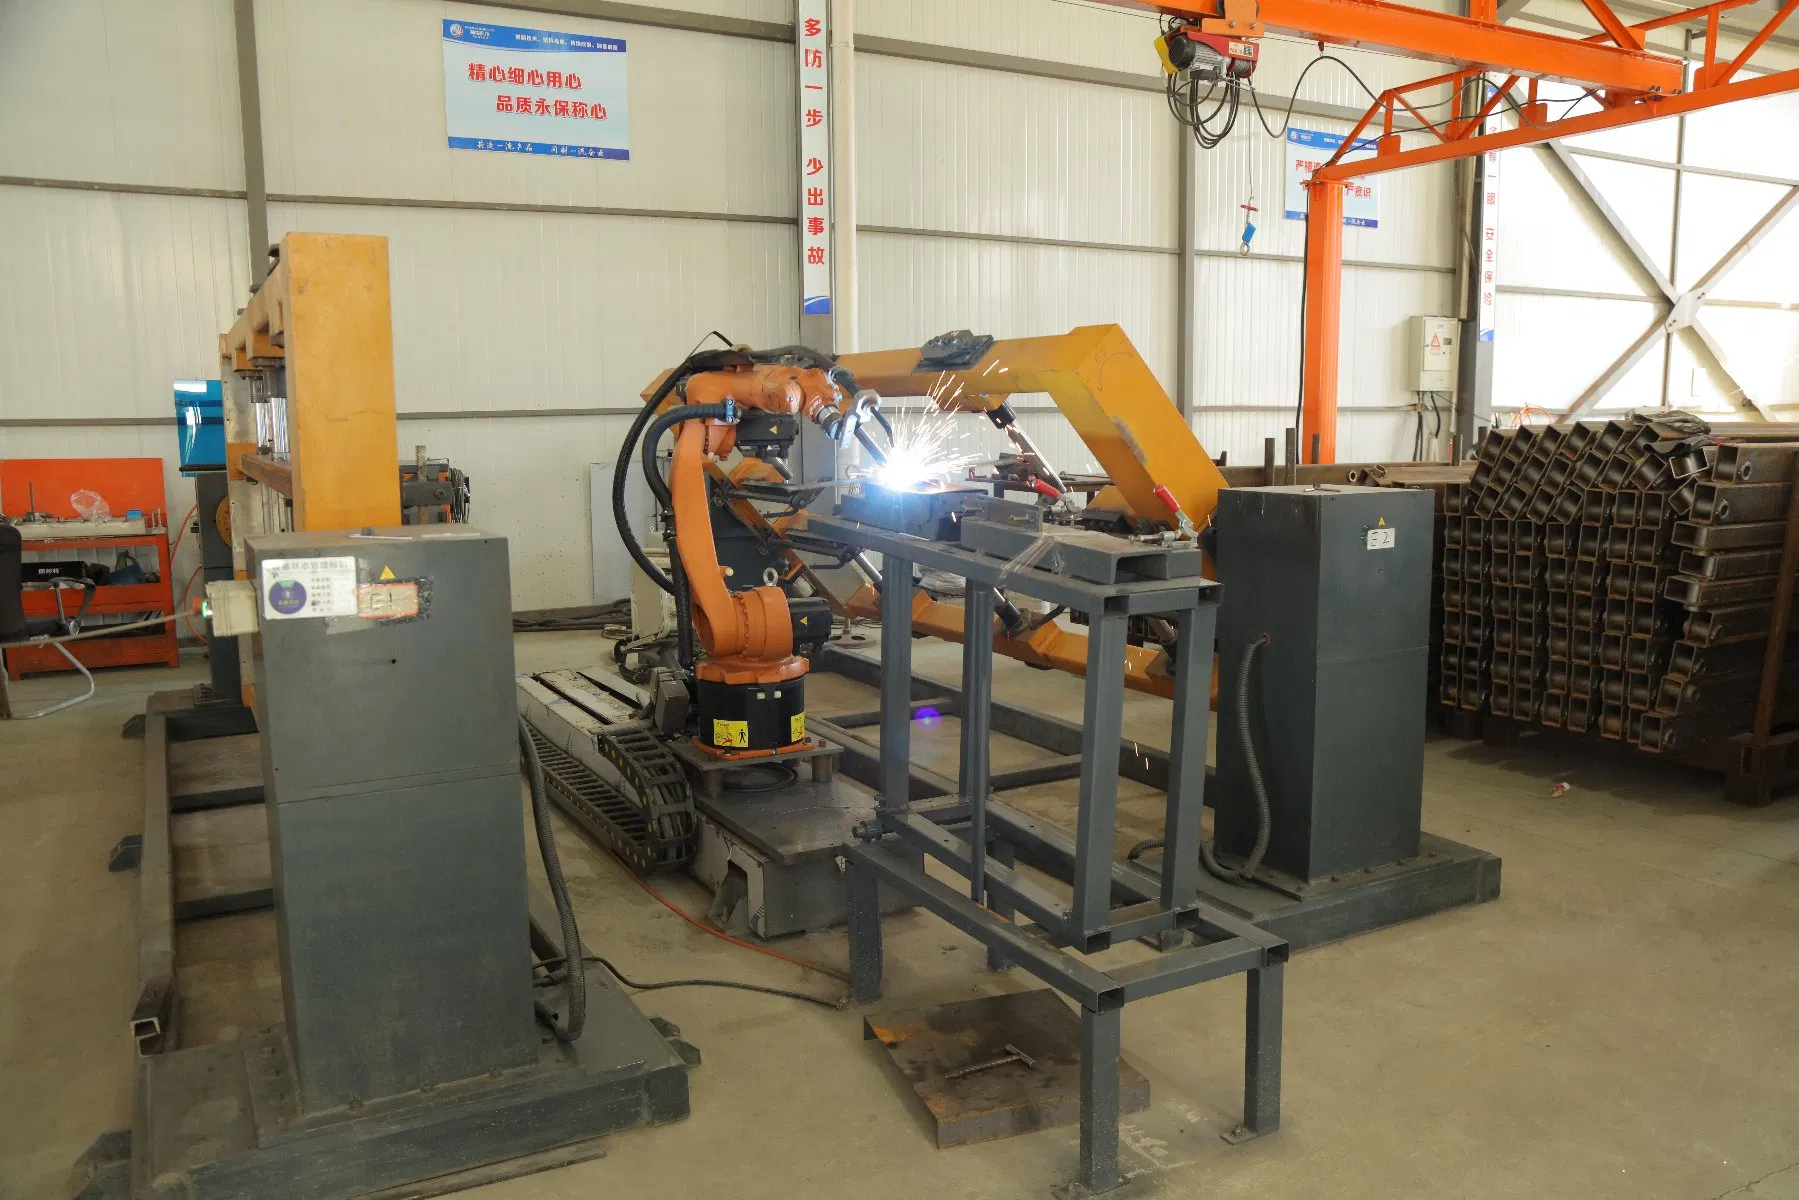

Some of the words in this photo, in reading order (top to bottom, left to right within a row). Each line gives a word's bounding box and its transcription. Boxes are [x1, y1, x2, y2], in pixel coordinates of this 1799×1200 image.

[468, 63, 582, 90] 精心细心用心
[804, 18, 824, 127] 多防一步
[496, 95, 607, 120] 品质永保称心
[806, 157, 825, 266] 少出事故
[1370, 531, 1390, 547] E2
